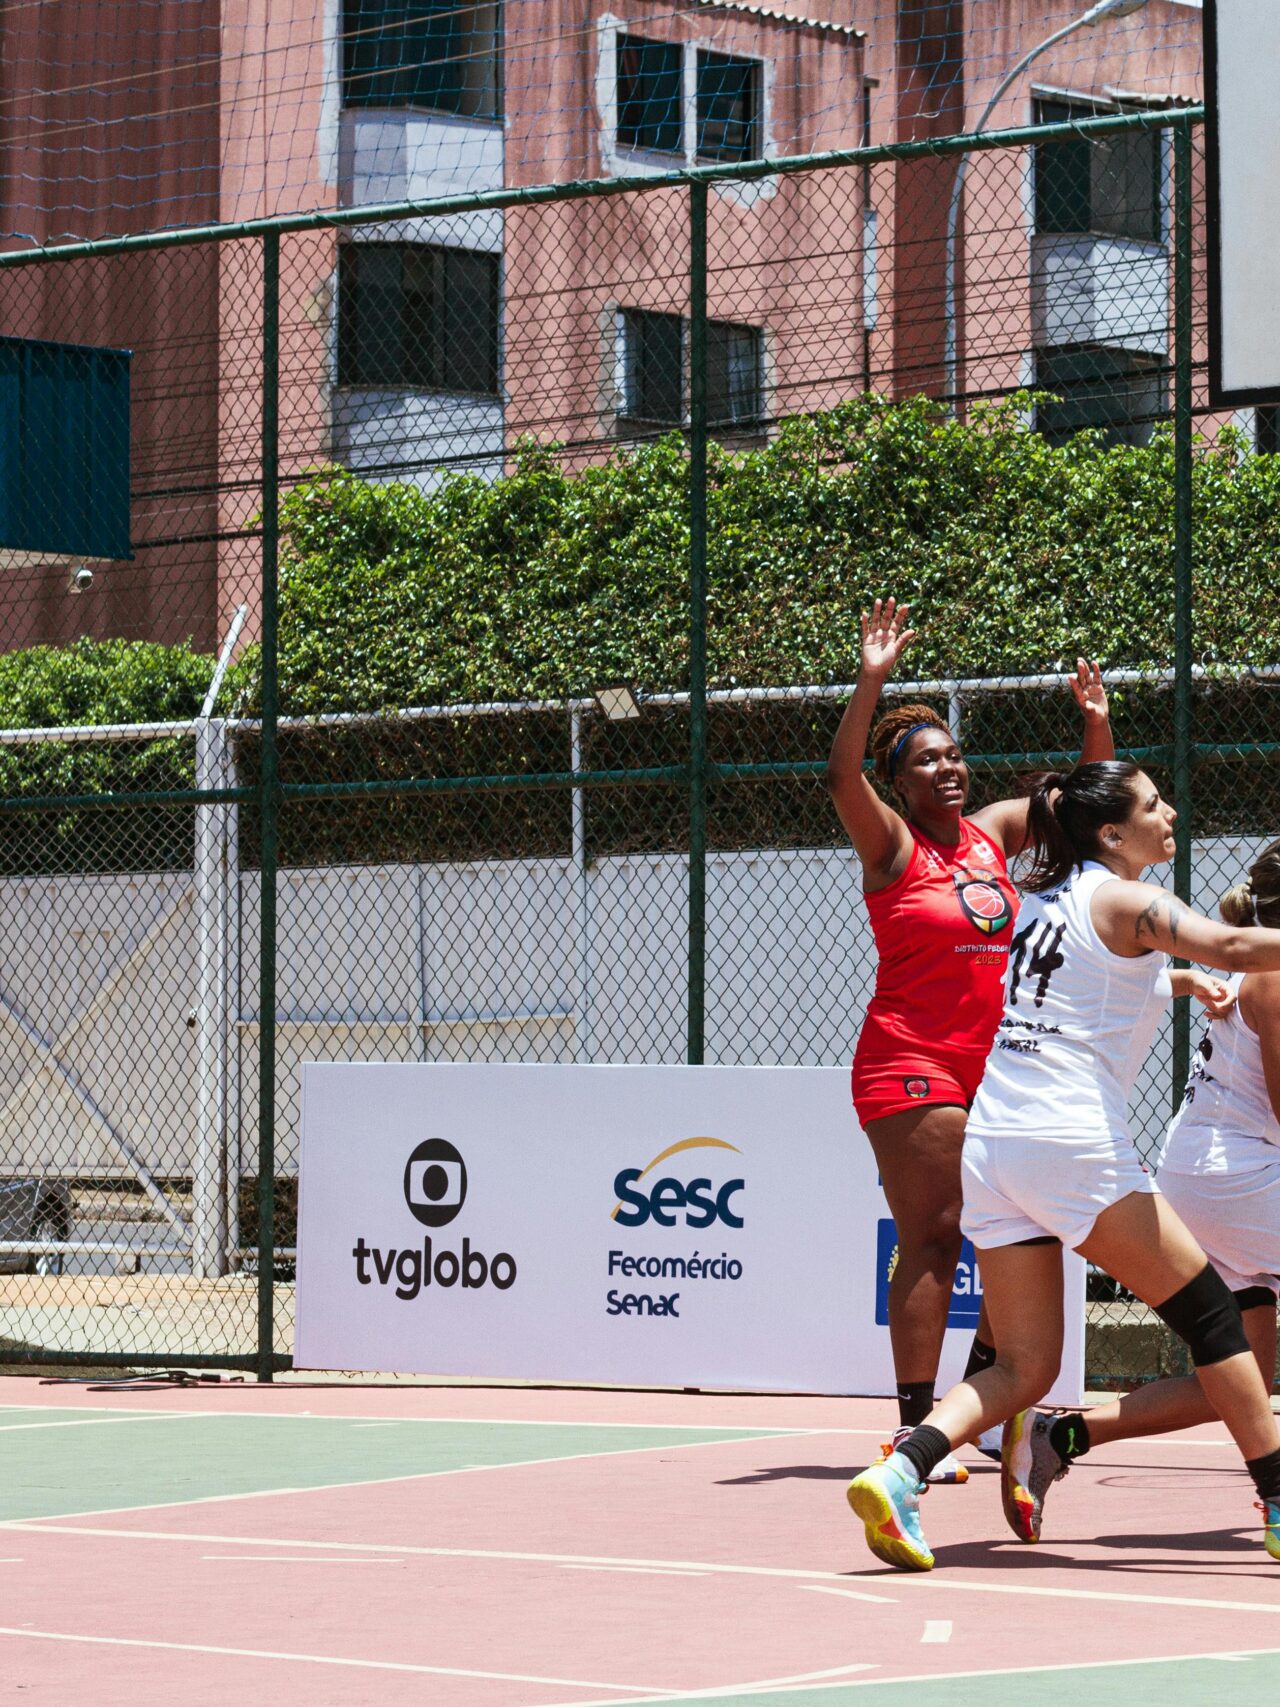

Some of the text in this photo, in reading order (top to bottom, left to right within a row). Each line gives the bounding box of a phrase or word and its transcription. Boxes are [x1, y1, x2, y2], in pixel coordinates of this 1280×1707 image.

[1009, 917, 1067, 1008] 14
[612, 1167, 745, 1229] Sesc
[352, 1235, 517, 1301] tvglobo
[608, 1250, 743, 1281] Fecomércio
[606, 1289, 680, 1318] Senac
